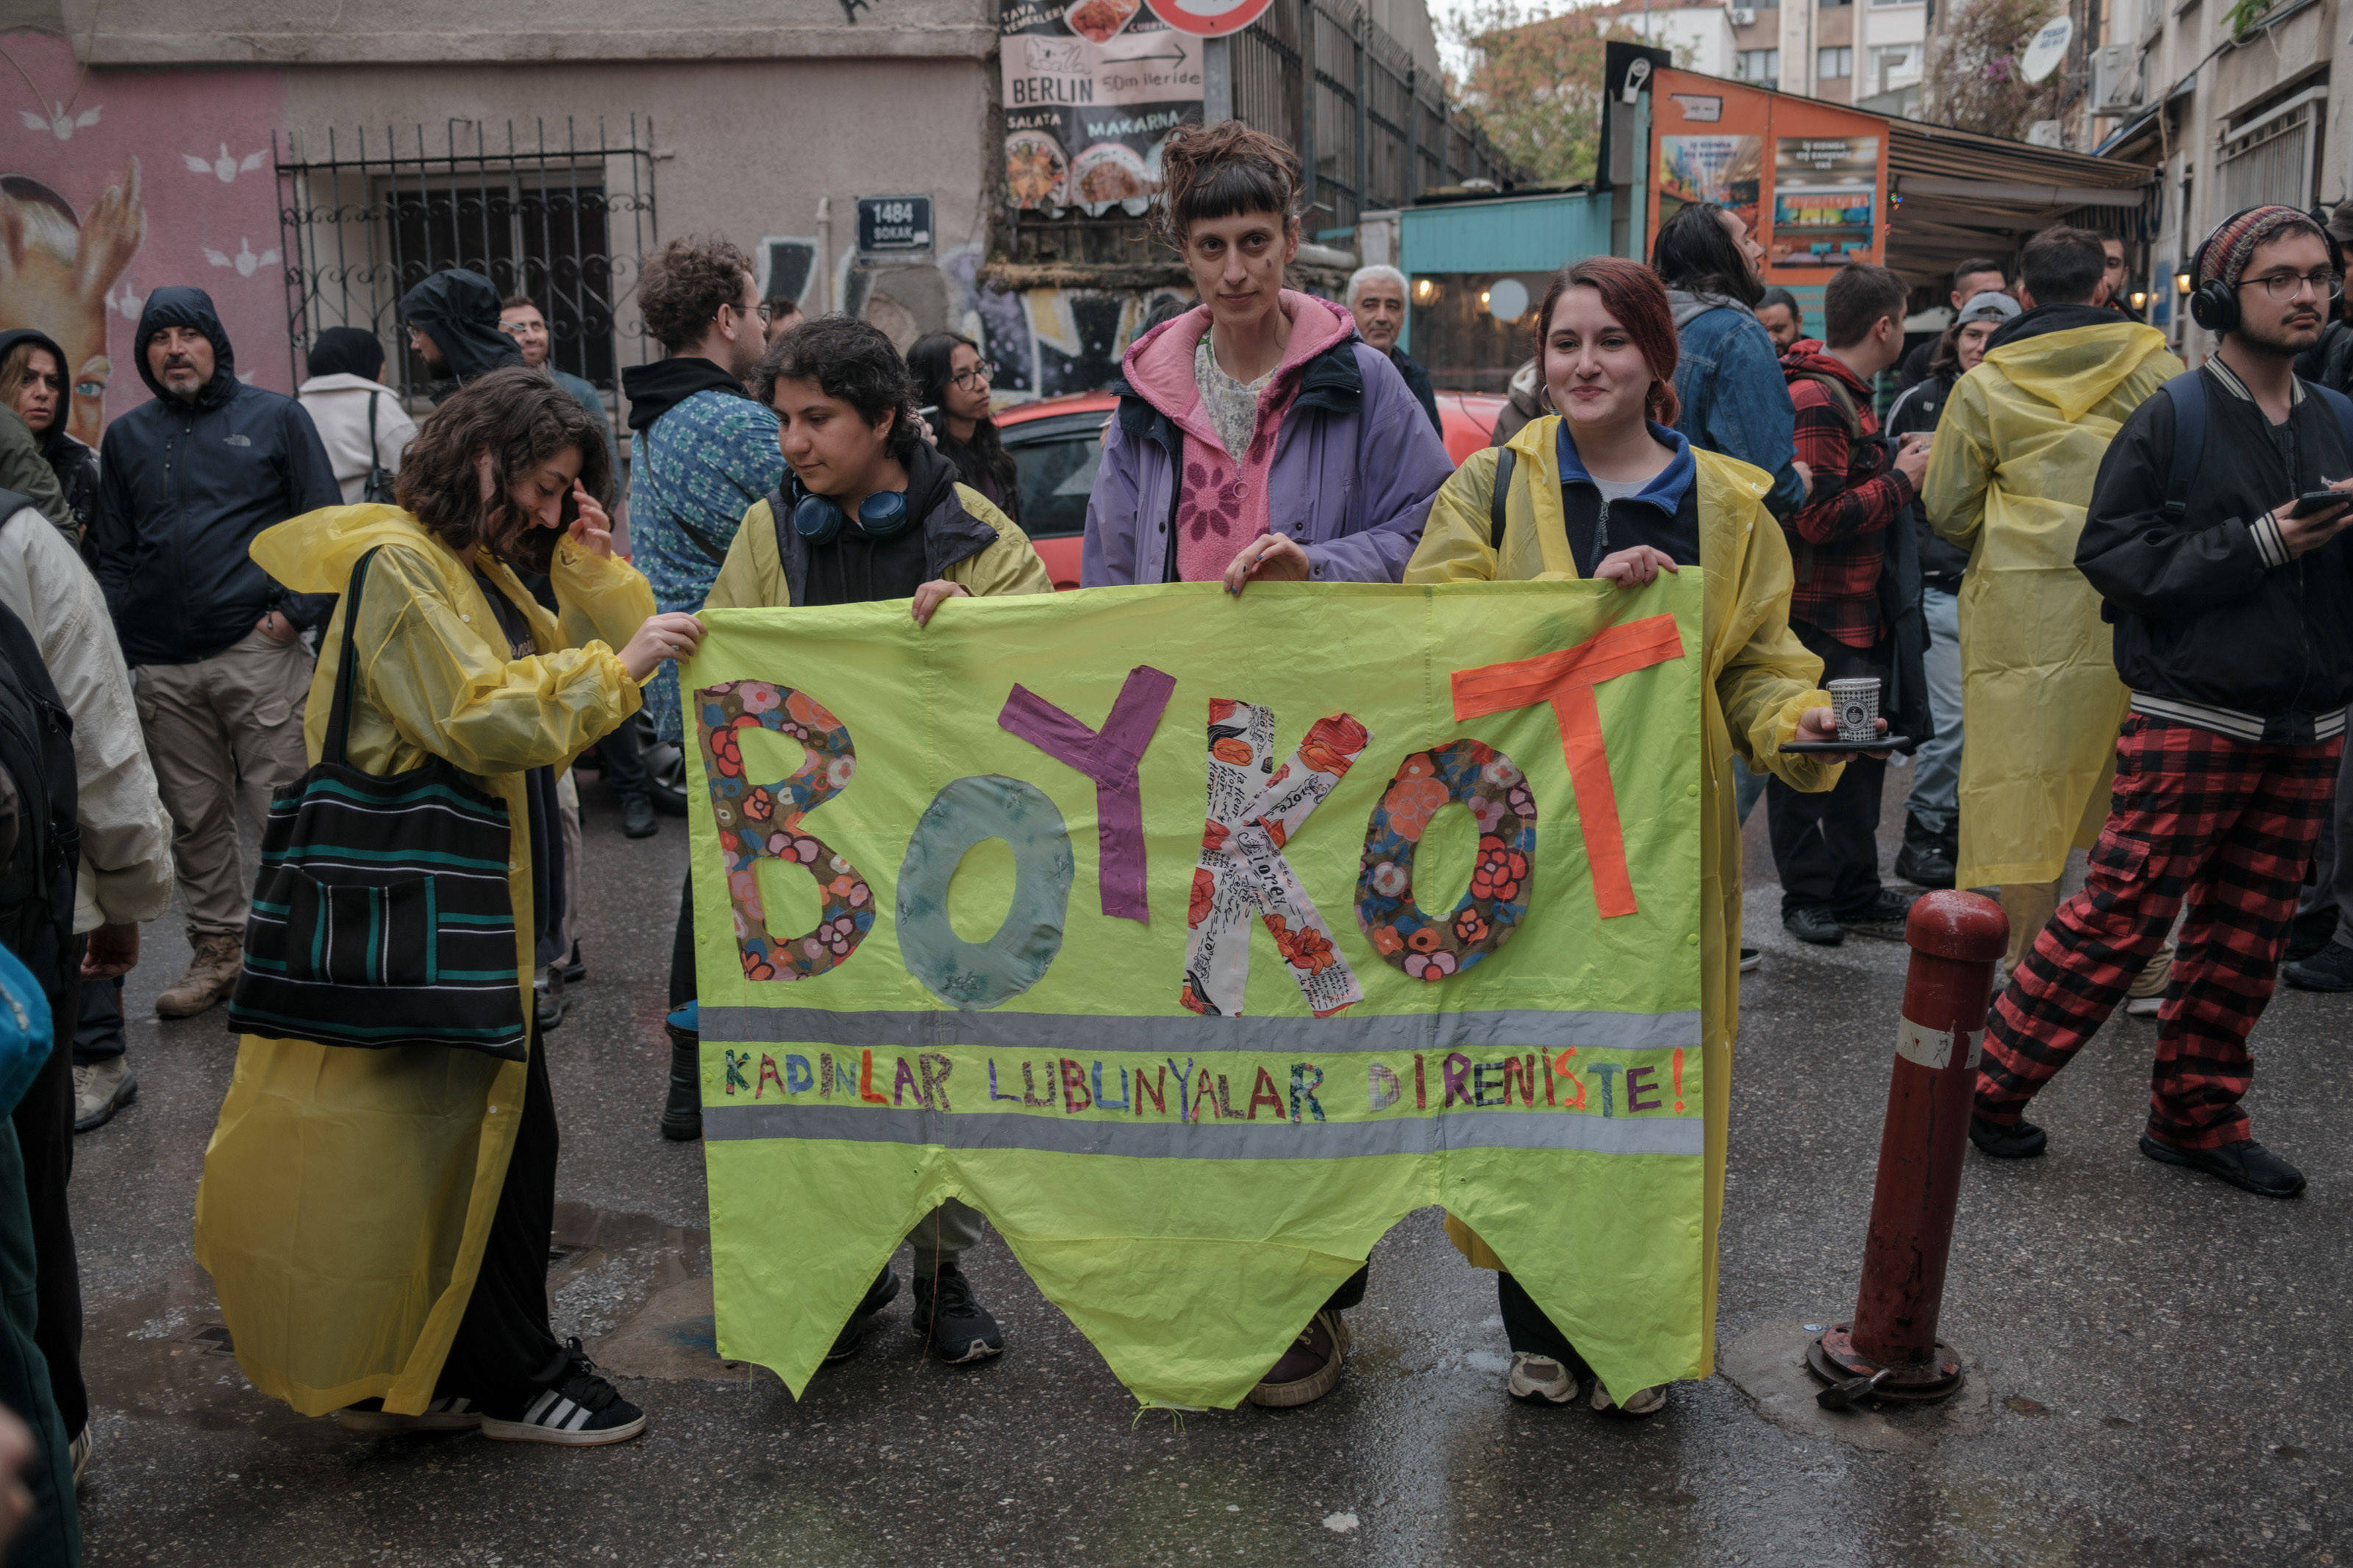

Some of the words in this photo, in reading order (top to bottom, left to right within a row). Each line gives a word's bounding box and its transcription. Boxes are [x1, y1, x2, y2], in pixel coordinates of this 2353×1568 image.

[1143, 71, 1201, 85] ileride
[1013, 77, 1093, 104] BERLIN
[1007, 113, 1062, 129] SALATA
[1088, 110, 1179, 137] MAKARNA
[873, 202, 914, 223] 1484
[874, 226, 913, 240] SOKAK
[693, 612, 1685, 1017] BOYKOT
[725, 1049, 952, 1111] KADINLAR
[988, 1057, 1327, 1123] LUBUNYALAR
